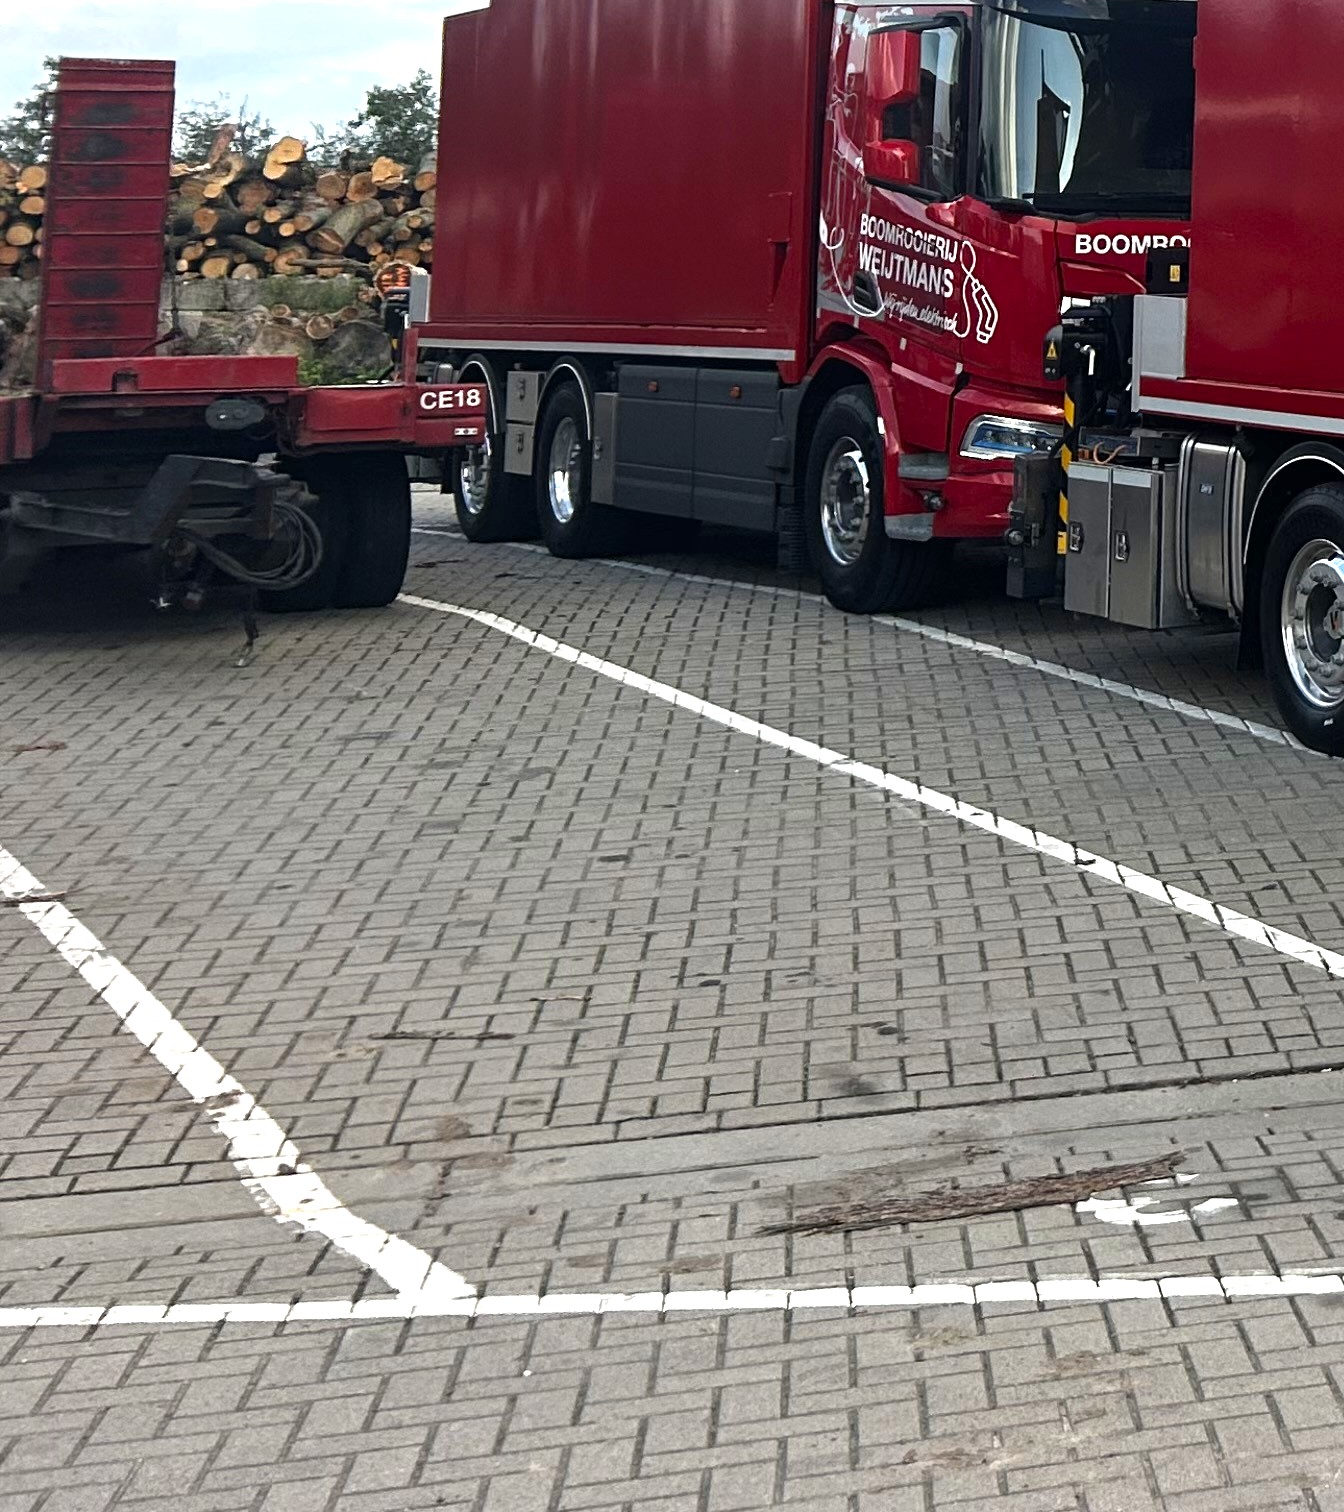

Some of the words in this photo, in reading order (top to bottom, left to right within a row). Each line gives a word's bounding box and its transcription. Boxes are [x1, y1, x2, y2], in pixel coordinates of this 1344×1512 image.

[860, 213, 959, 263] BOOMROOIERIJ
[1075, 234, 1191, 254] BOOMRO
[859, 241, 955, 298] WEIJTMANS
[420, 389, 481, 409] CE18
